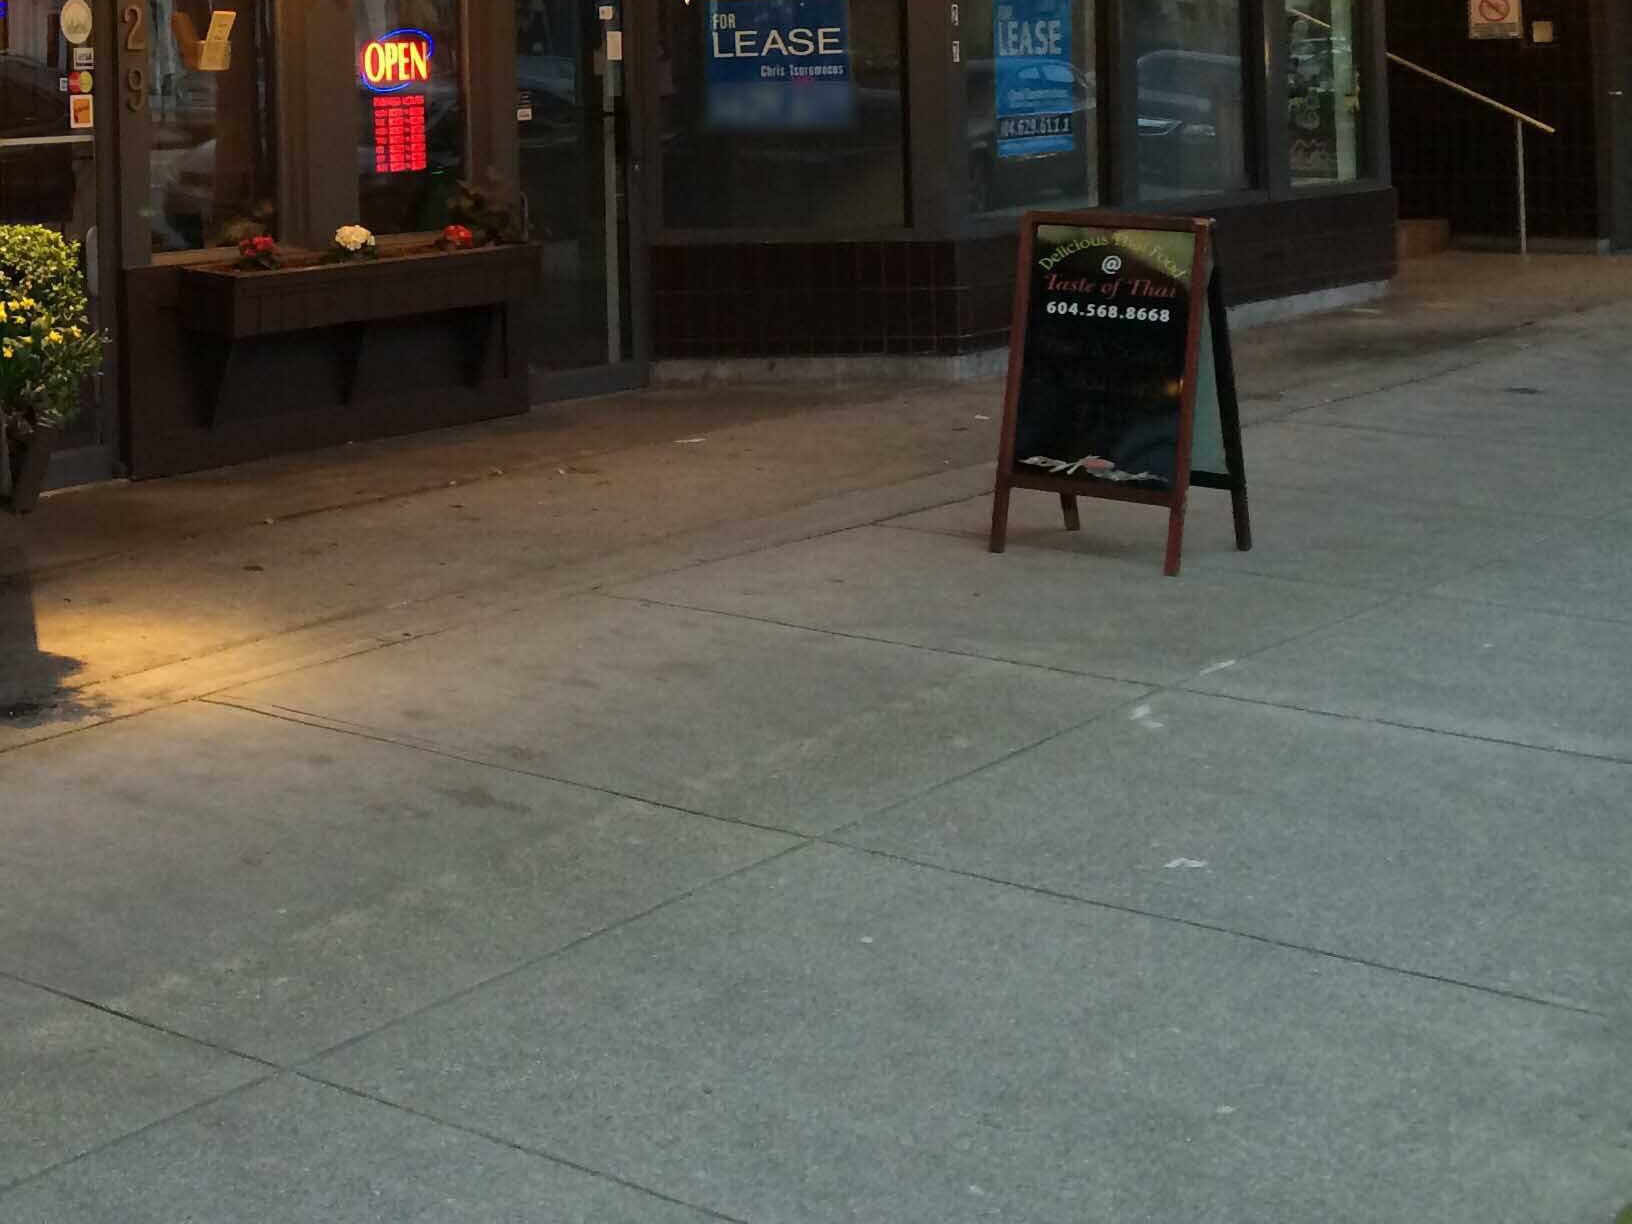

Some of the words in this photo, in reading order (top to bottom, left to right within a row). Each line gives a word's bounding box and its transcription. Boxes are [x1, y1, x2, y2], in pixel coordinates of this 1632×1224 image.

[711, 13, 736, 30] FOR
[711, 27, 844, 59] LEASE
[998, 19, 1062, 57] LEASE
[363, 39, 429, 84] OPEN
[760, 64, 785, 77] Chris
[1038, 236, 1109, 271] Delicious
[1101, 255, 1122, 275] @
[1044, 273, 1095, 294] Taste
[1101, 278, 1120, 300] of
[1129, 279, 1177, 298] Thai
[1046, 301, 1171, 323] 604.568.8668
